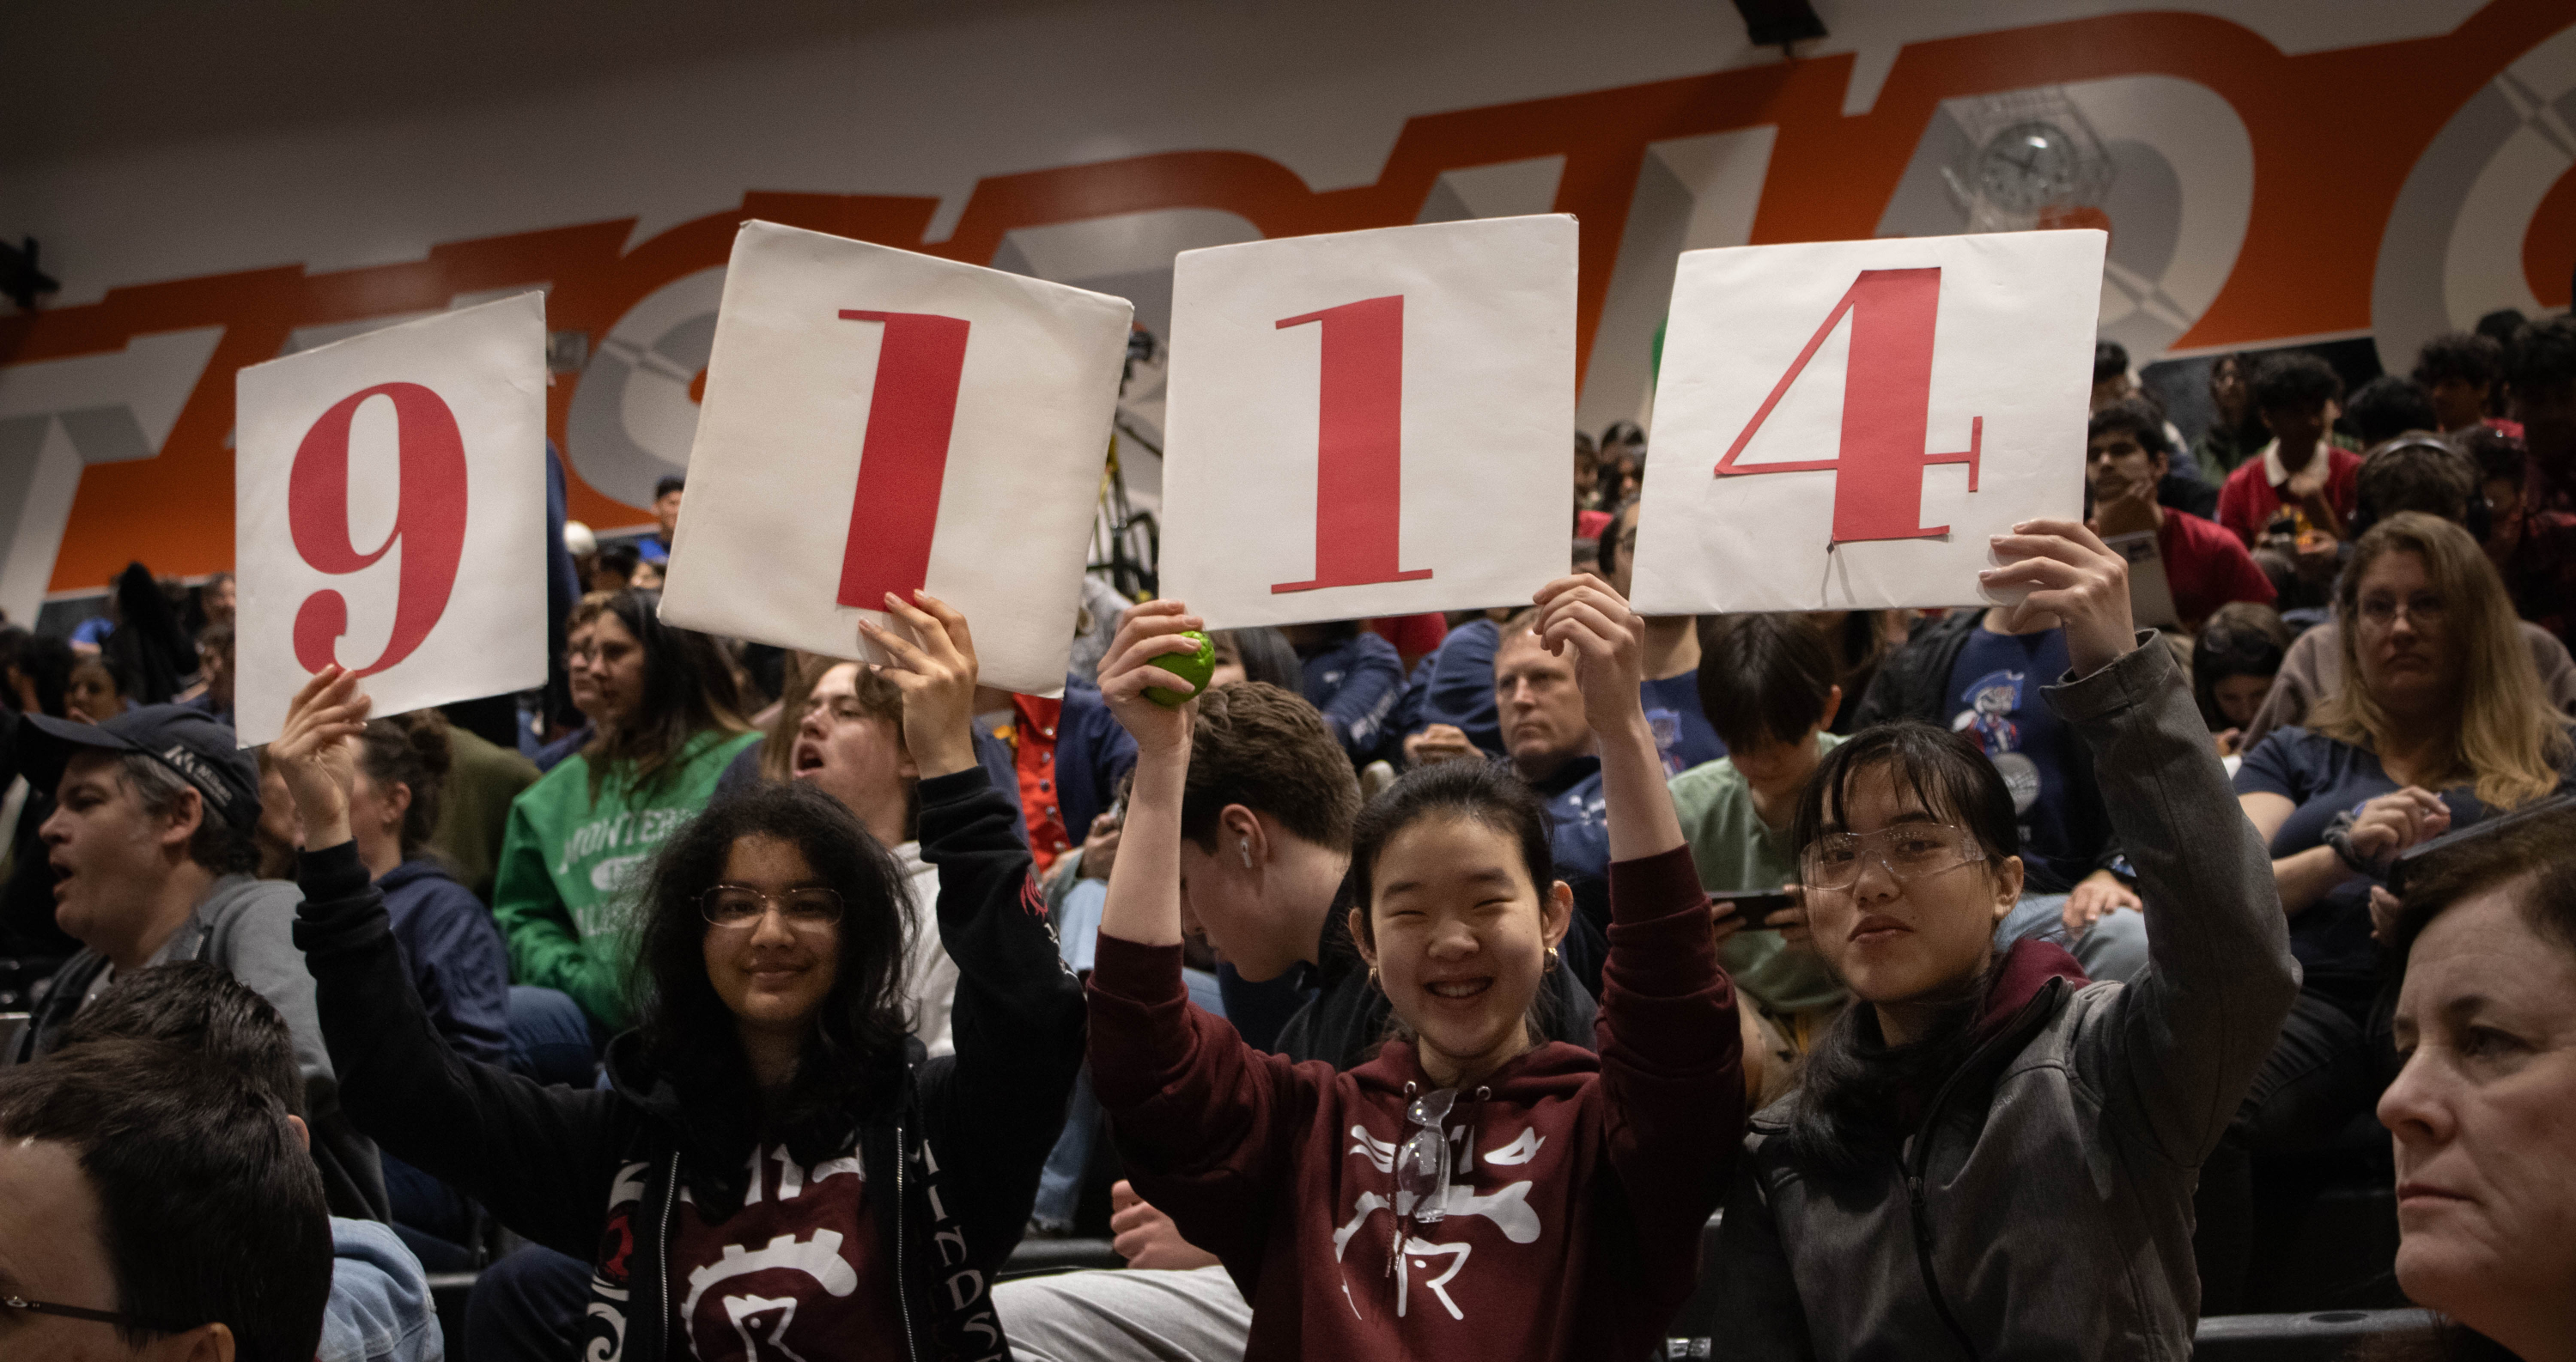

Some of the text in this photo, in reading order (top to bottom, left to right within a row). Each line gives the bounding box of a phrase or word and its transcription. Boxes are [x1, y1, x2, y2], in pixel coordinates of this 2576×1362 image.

[289, 383, 466, 677] 9
[837, 309, 969, 615] 1
[1272, 295, 1432, 593] 1
[1715, 267, 1982, 543] 4
